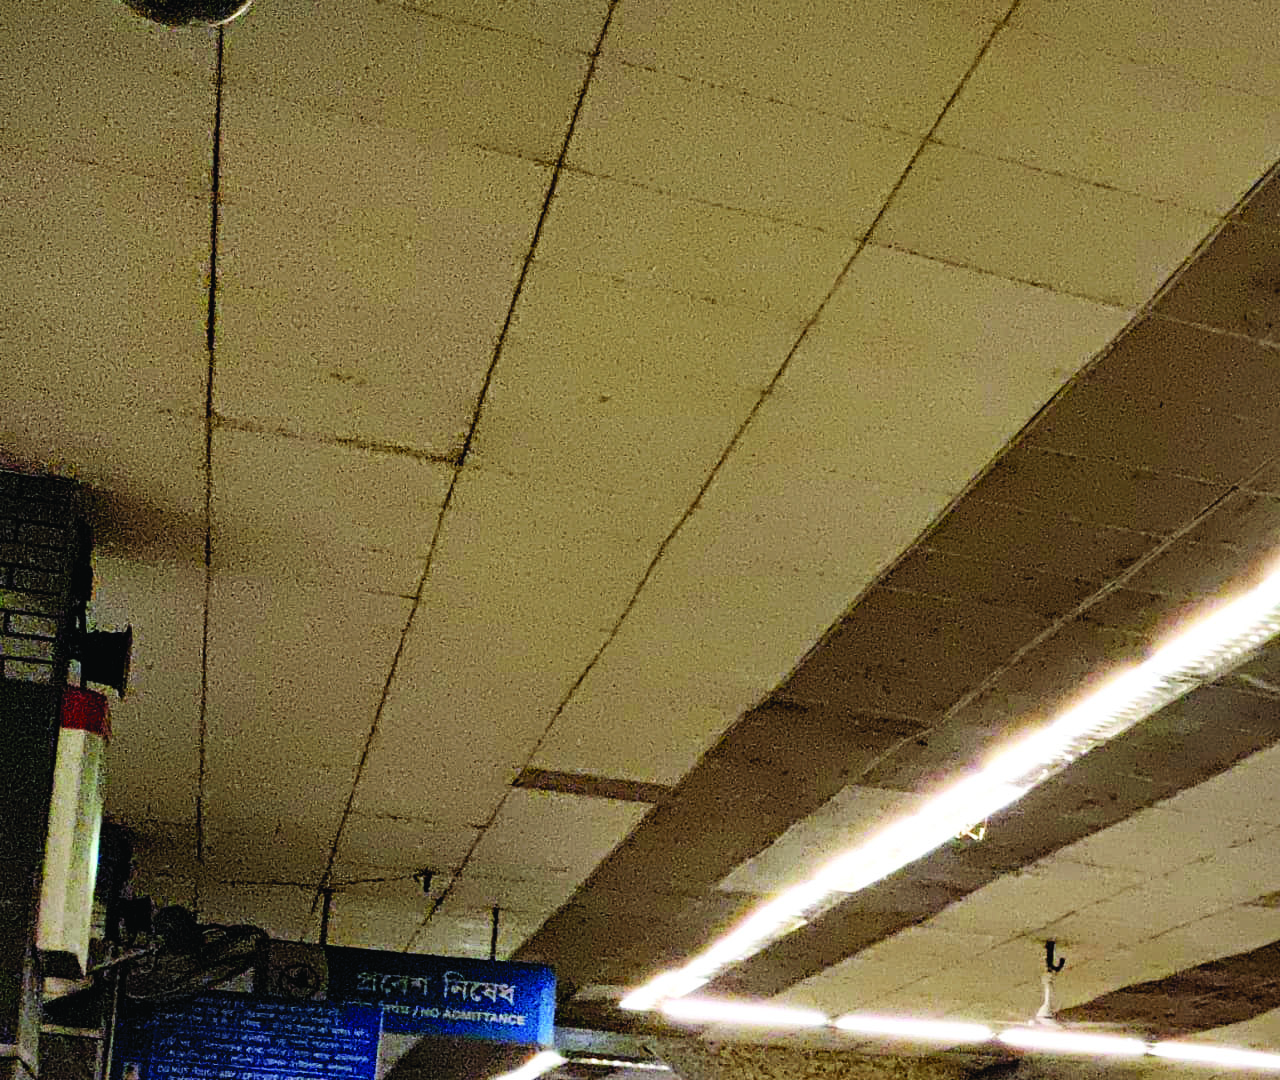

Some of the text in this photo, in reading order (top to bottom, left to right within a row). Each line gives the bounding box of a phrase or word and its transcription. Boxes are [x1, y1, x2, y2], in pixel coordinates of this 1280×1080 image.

[356, 970, 517, 1006] প্রবেশ নিষেধ
[443, 1008, 527, 1026] ADMITTANCE
